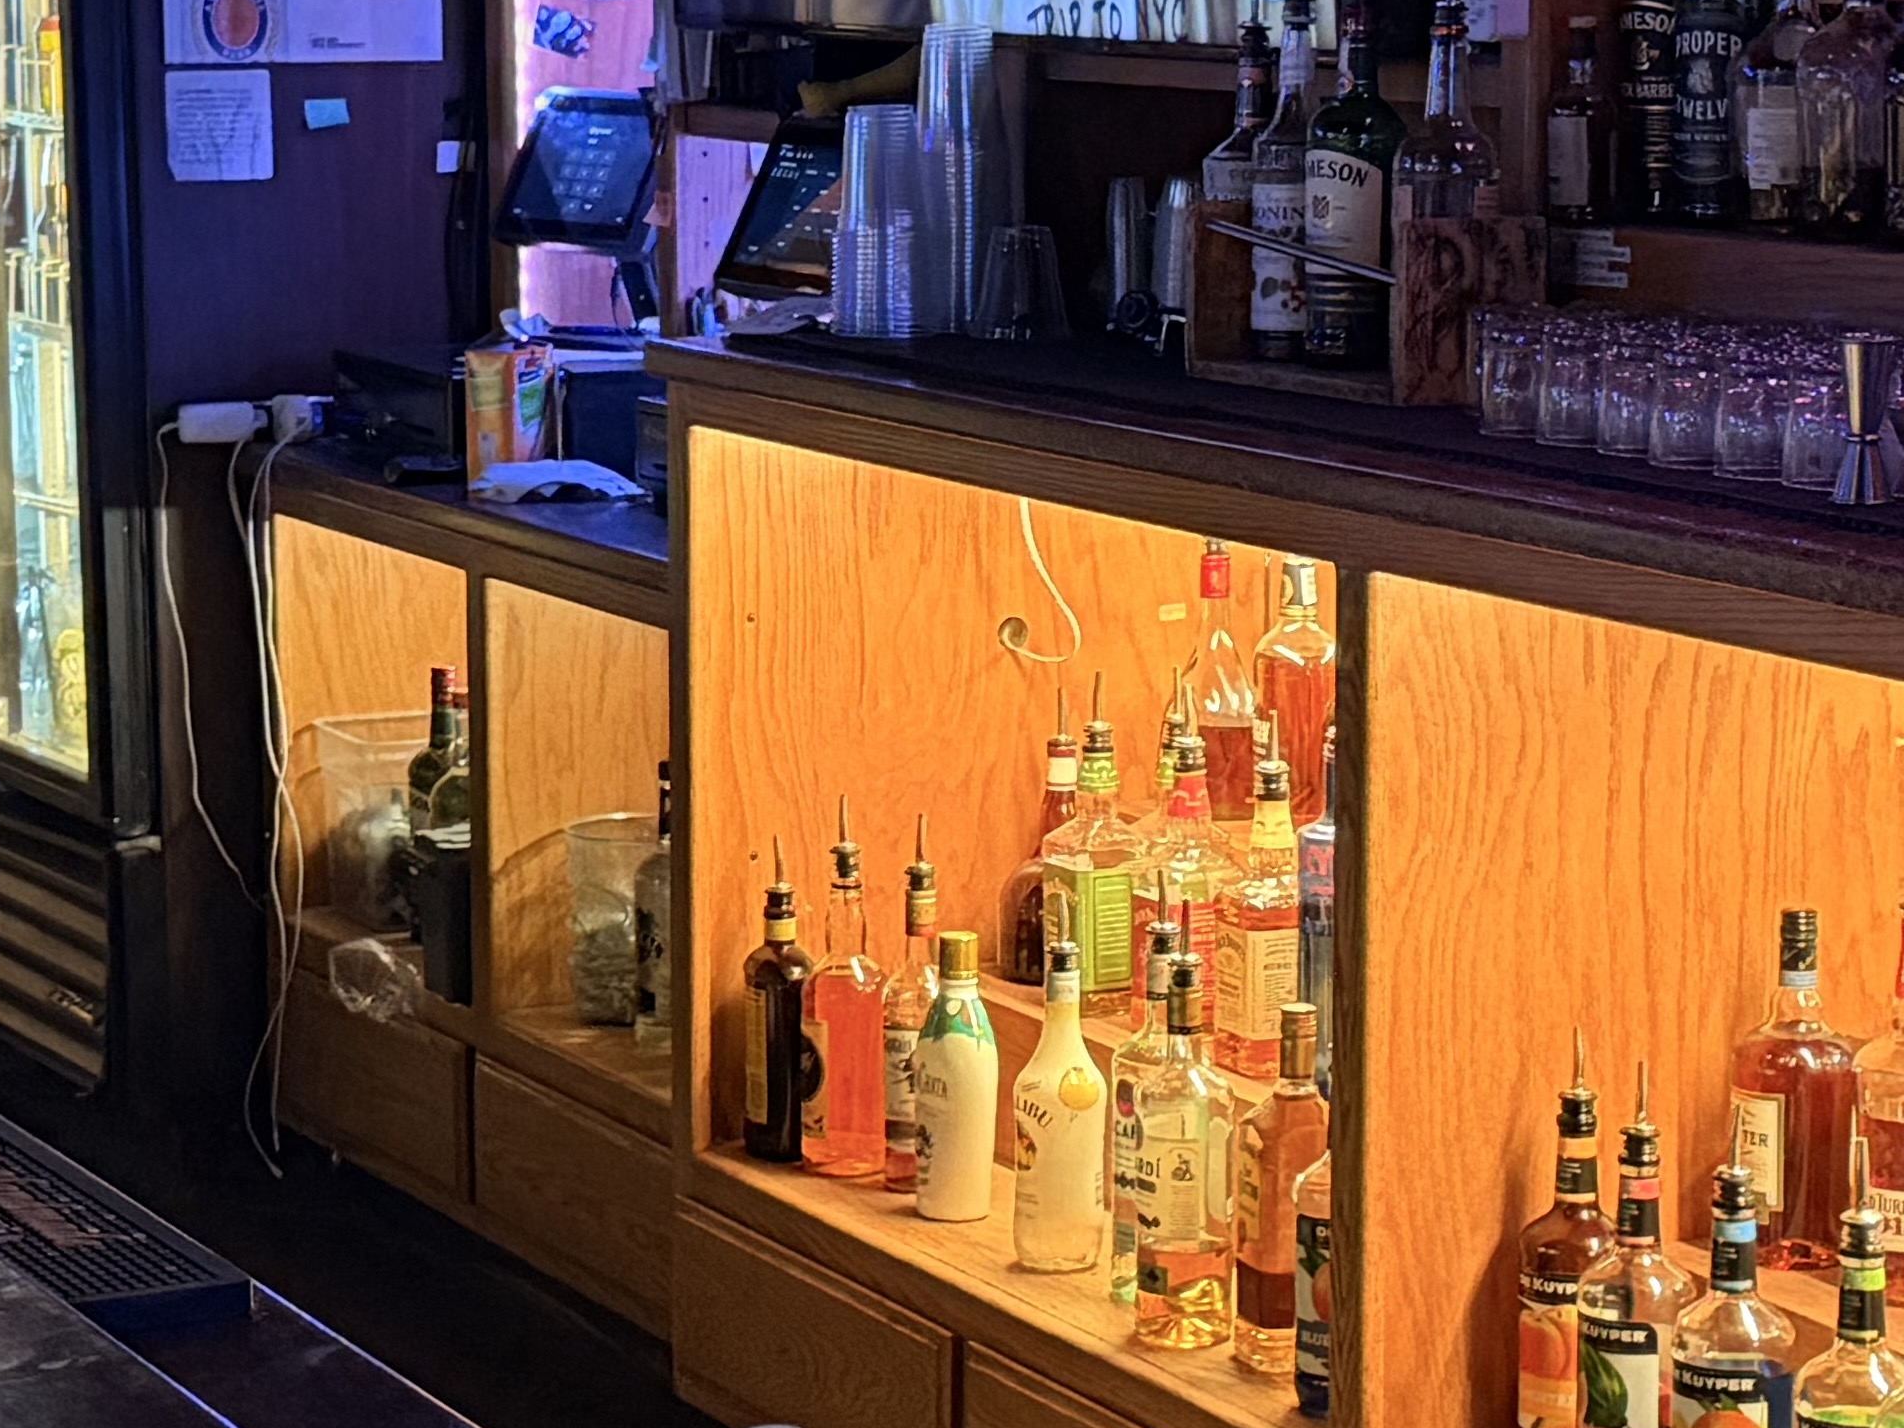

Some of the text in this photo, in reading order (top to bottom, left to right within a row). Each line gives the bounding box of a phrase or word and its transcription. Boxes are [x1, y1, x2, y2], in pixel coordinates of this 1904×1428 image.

[1676, 93, 1728, 121] TWELV
[1532, 1277, 1579, 1296] KUYP
[1682, 1371, 1757, 1392] KUYPER
